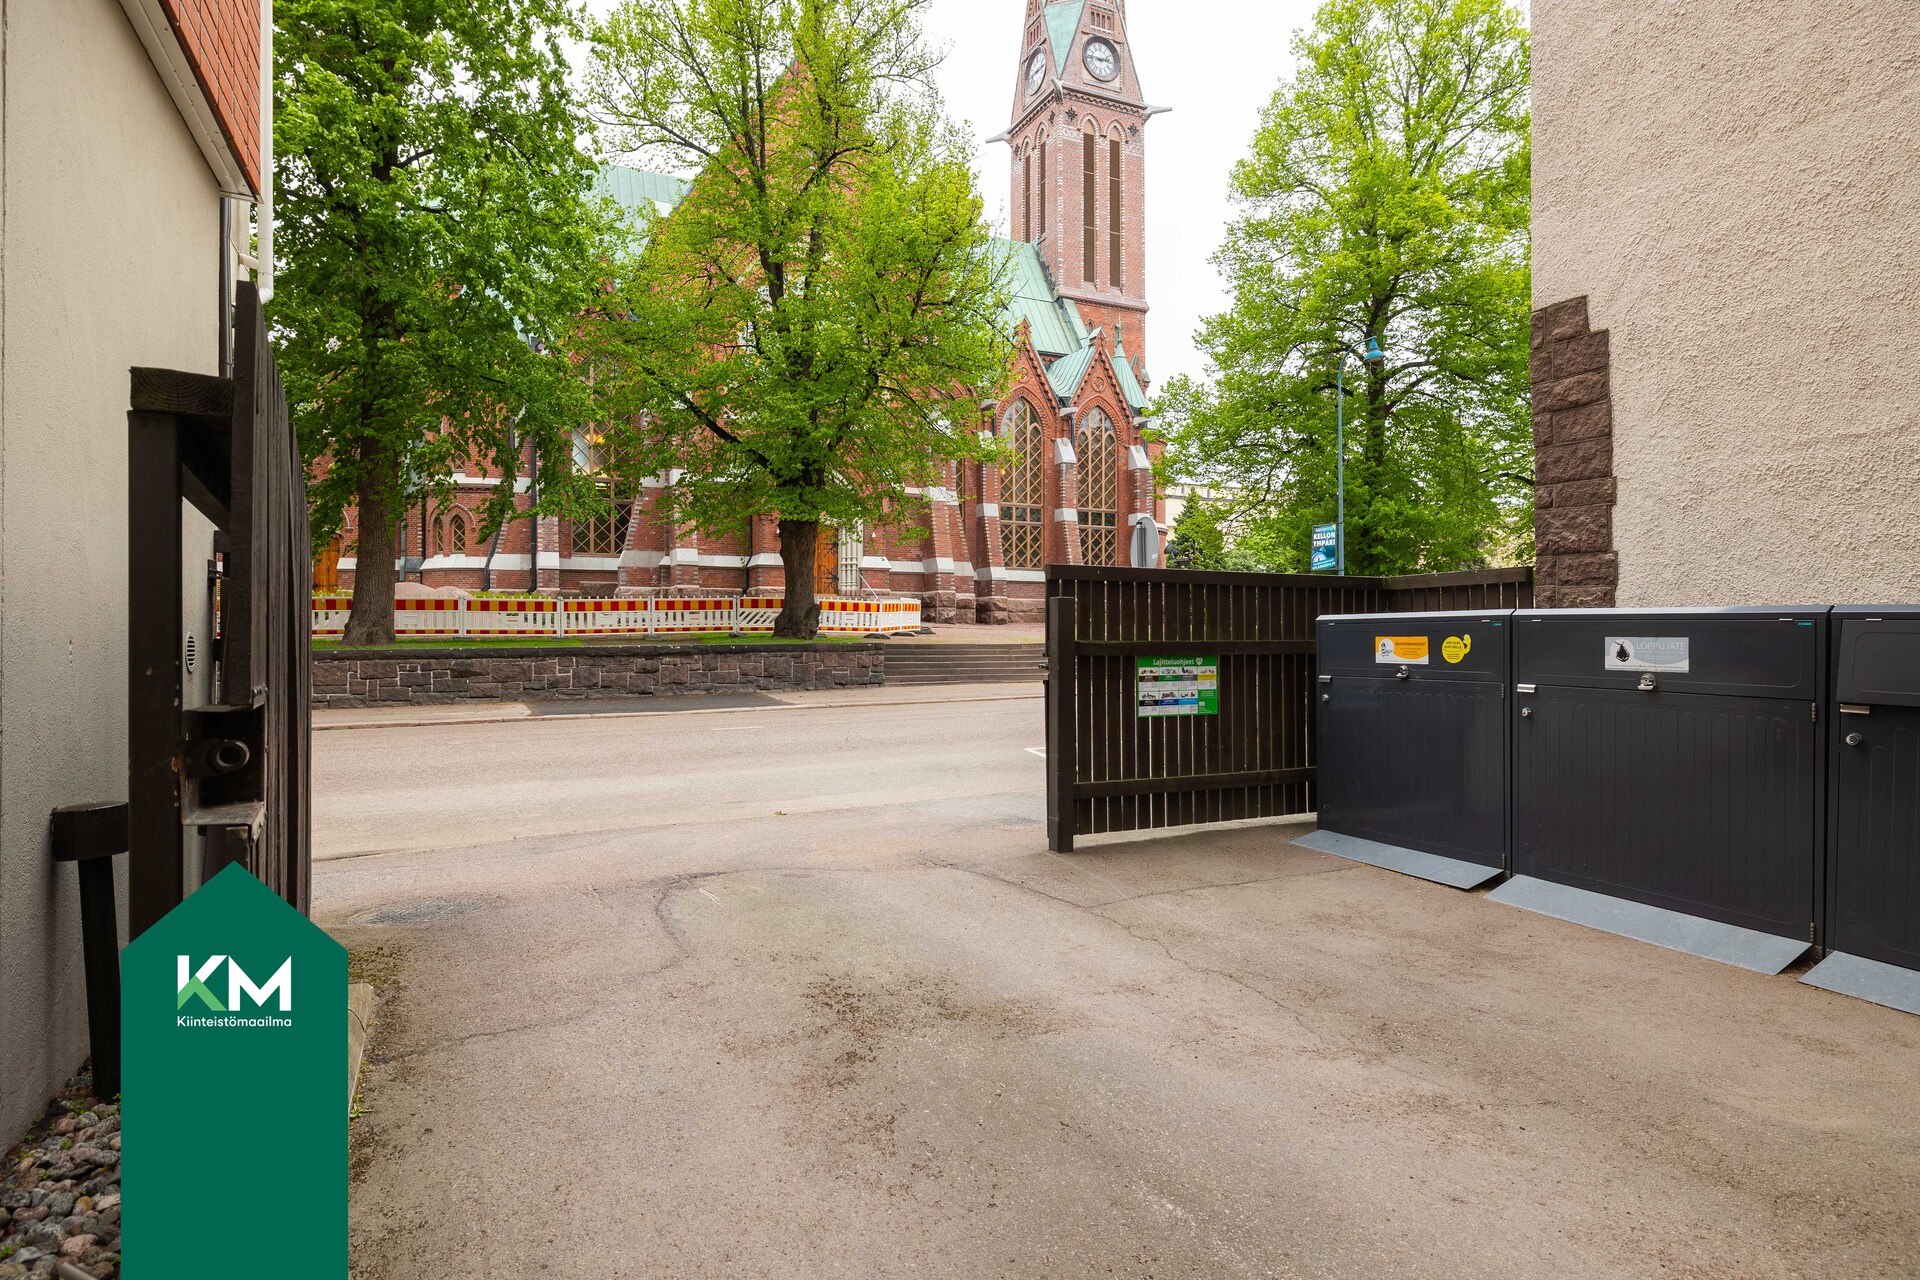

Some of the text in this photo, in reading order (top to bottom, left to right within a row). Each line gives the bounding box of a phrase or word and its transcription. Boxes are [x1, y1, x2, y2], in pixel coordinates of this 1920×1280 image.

[1313, 532, 1336, 540] KELLON
[1636, 640, 1686, 650] LOPPUJÄTE
[1153, 658, 1195, 666] Lajitteluohjeet
